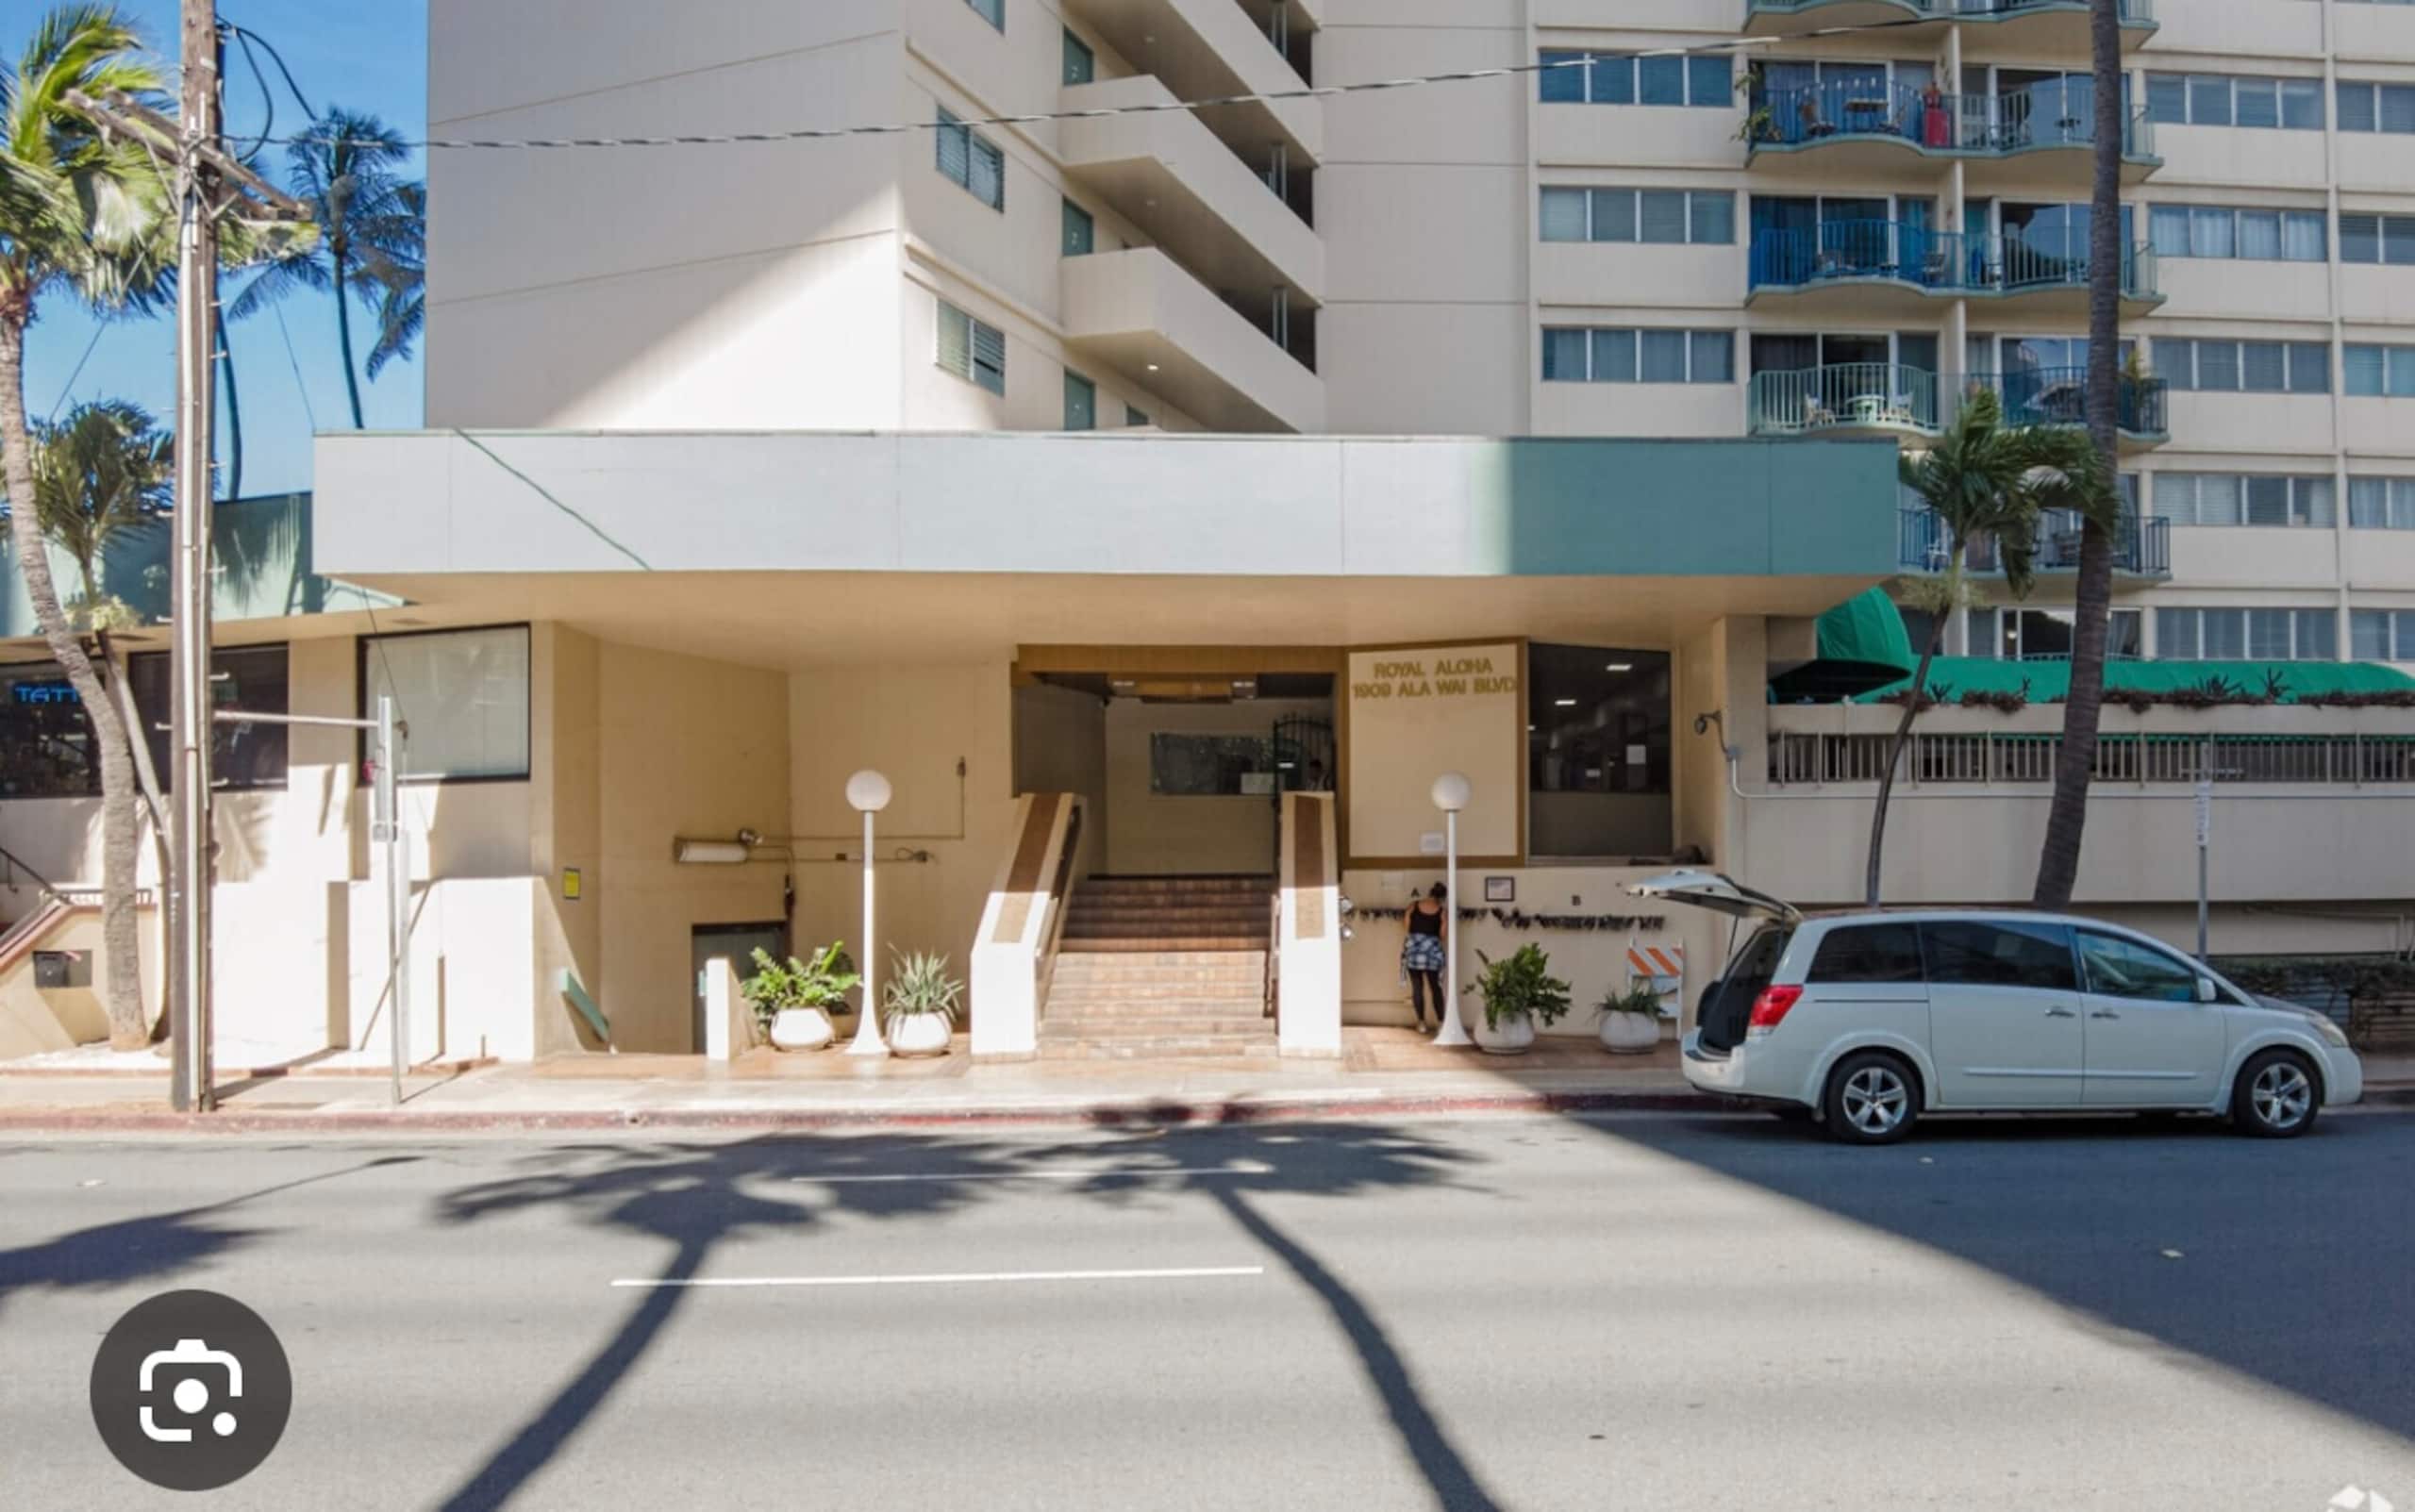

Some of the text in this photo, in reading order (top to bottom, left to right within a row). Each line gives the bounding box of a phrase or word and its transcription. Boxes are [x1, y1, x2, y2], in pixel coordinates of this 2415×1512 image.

[1373, 657, 1493, 678] ROYAL ALOHA
[1398, 680, 1431, 697] ALA
[1435, 678, 1466, 695] WAI
[1474, 676, 1516, 694] BLVD
